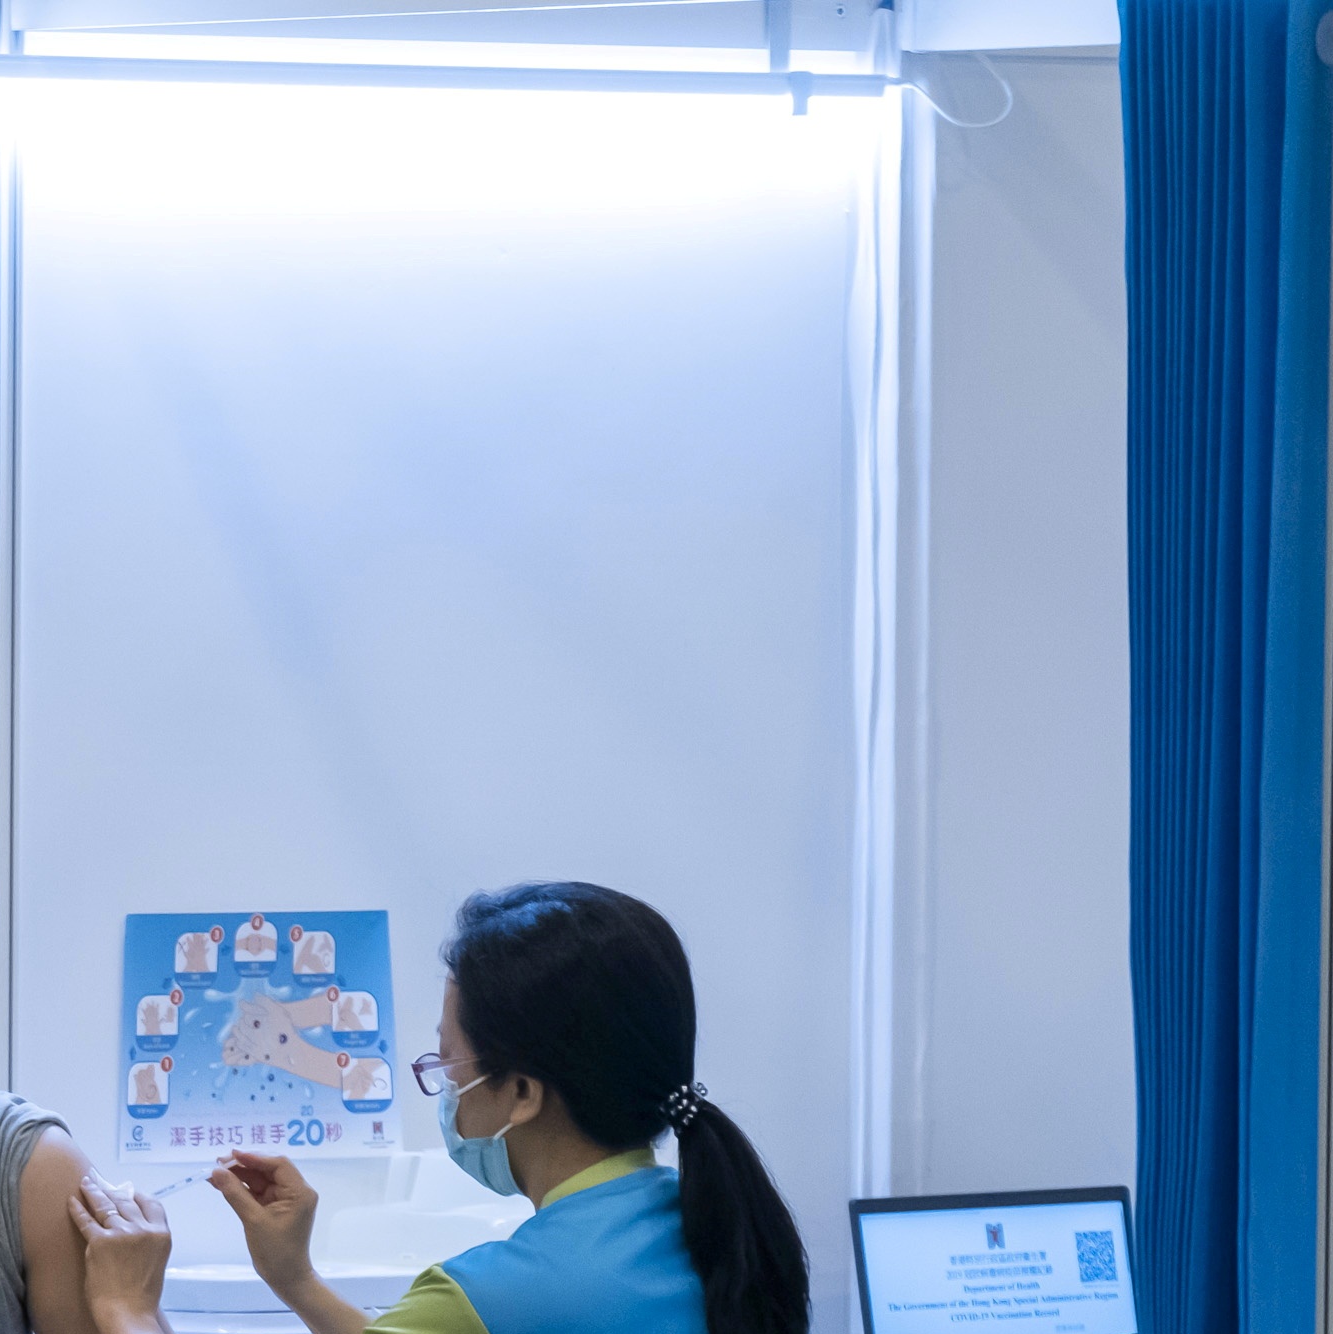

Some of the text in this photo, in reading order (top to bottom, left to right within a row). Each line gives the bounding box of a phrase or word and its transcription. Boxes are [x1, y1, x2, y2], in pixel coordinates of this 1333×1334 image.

[170, 1125, 243, 1146] 潔手技巧
[963, 1284, 1006, 1295] Department
[1016, 1281, 1041, 1291] Health
[888, 1302, 902, 1312] The
[903, 1301, 948, 1311] Government
[958, 1299, 970, 1309] the
[970, 1298, 991, 1309] Hong
[992, 1297, 1012, 1308] Kong
[1013, 1295, 1039, 1307] Special
[1041, 1293, 1093, 1304] Administrative
[1093, 1291, 1119, 1302] Region
[951, 1308, 1060, 1323] COVID-19 Vaccination Record
